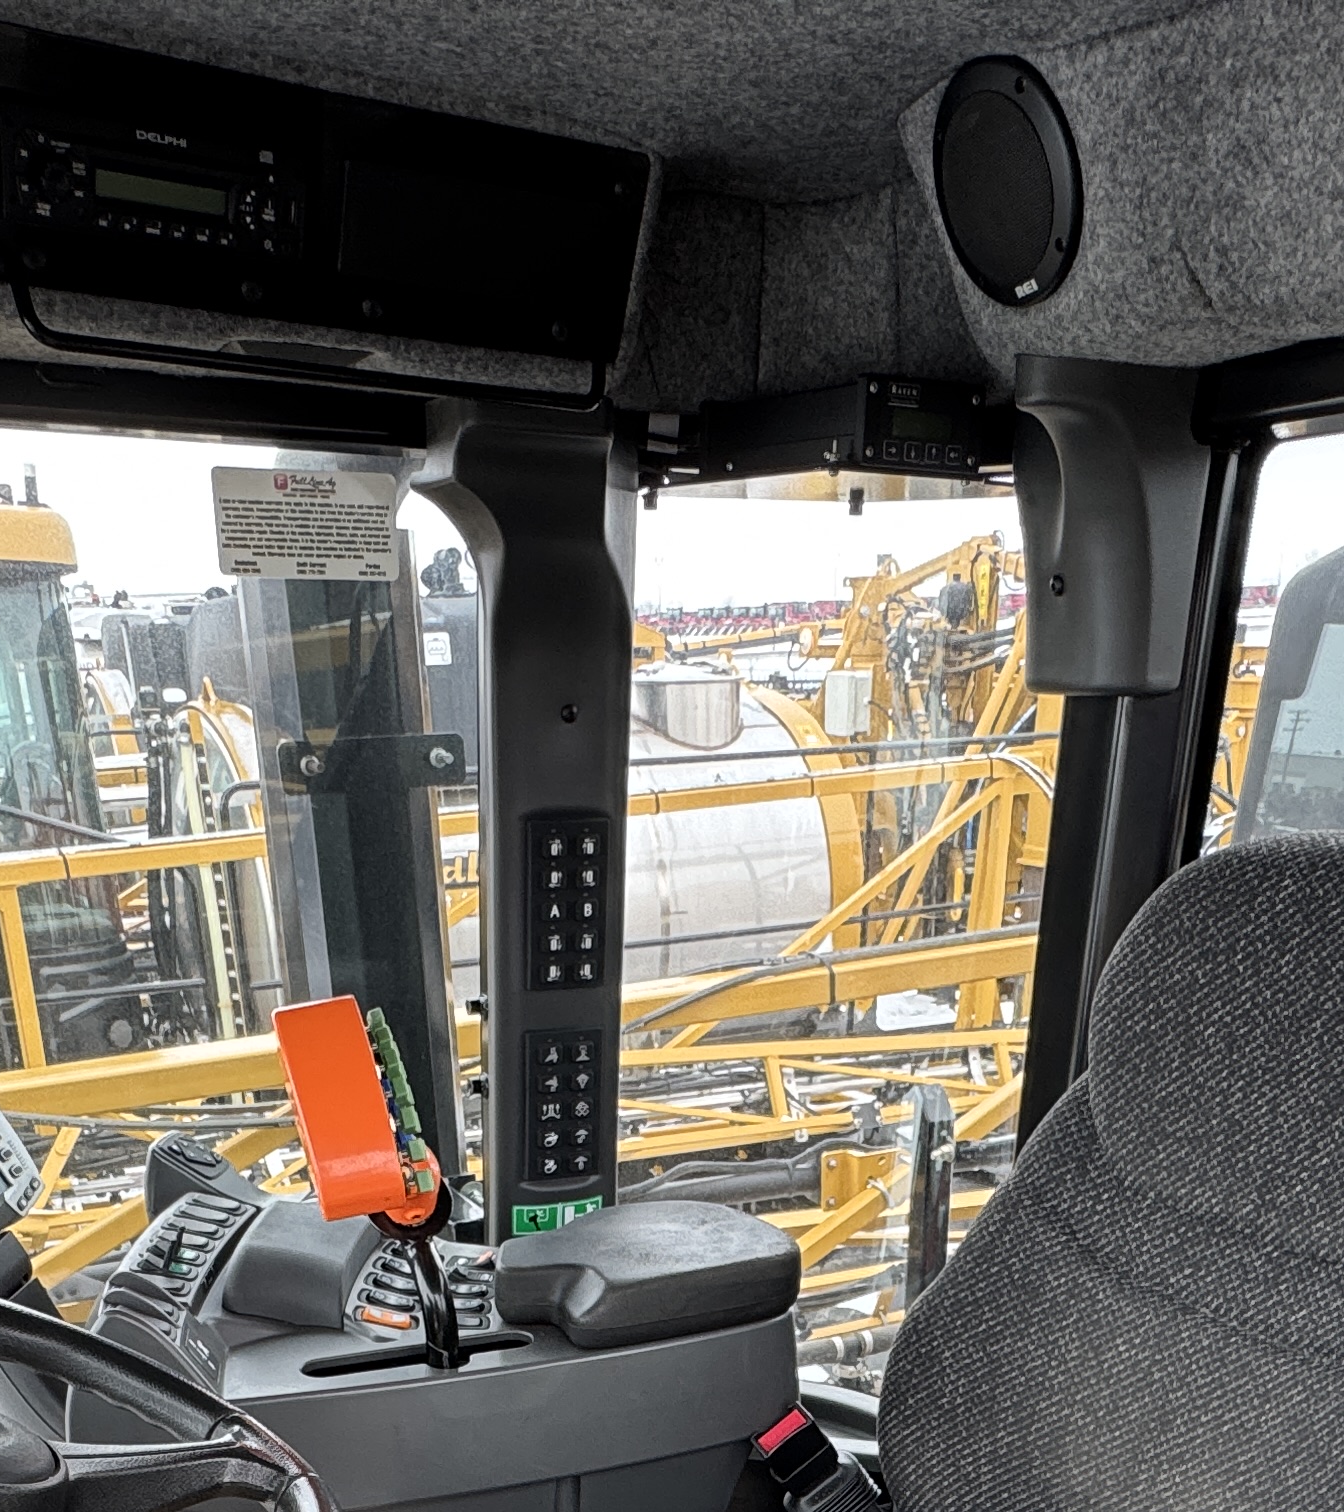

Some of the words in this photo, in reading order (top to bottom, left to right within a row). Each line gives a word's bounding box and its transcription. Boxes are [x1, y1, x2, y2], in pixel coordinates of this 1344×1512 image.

[135, 129, 187, 148] DELPHI
[1015, 278, 1038, 299] REI
[549, 904, 560, 919] A
[583, 903, 593, 918] B
